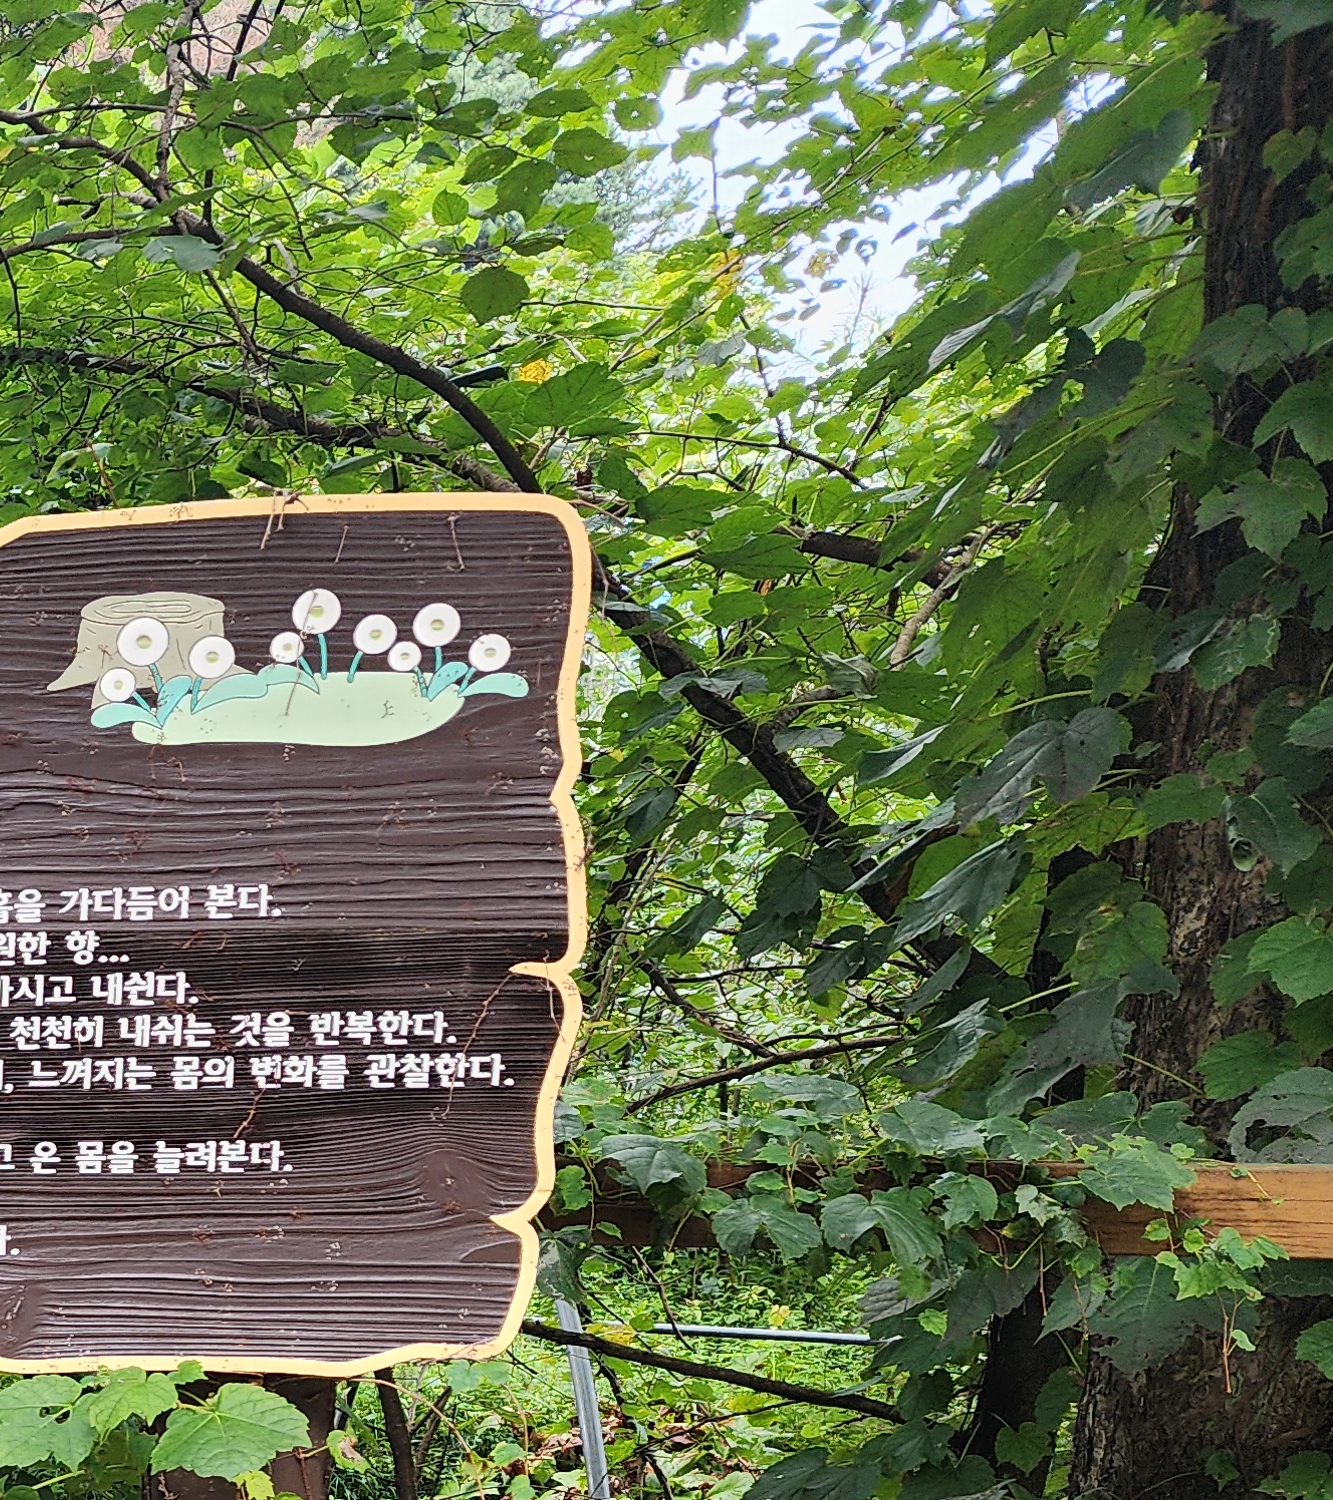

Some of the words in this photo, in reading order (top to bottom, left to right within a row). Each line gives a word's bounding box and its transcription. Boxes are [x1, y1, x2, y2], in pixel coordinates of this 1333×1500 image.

[58, 884, 190, 921] 가다듬어
[204, 883, 282, 917] 본다.
[91, 972, 199, 1006] 내쉰다.
[10, 1015, 104, 1050] 천천히
[119, 1014, 216, 1048] 내쉬는
[231, 1012, 295, 1047] 것을
[310, 1010, 457, 1046] 반복한다.
[29, 1057, 157, 1093] 느껴지는
[170, 1056, 235, 1090] 몸의
[250, 1054, 350, 1090] 변화를
[363, 1053, 515, 1090] 관찰한다.
[29, 1141, 61, 1174] 온
[75, 1141, 139, 1175] 몸을
[153, 1139, 294, 1175] 늘려본다.
